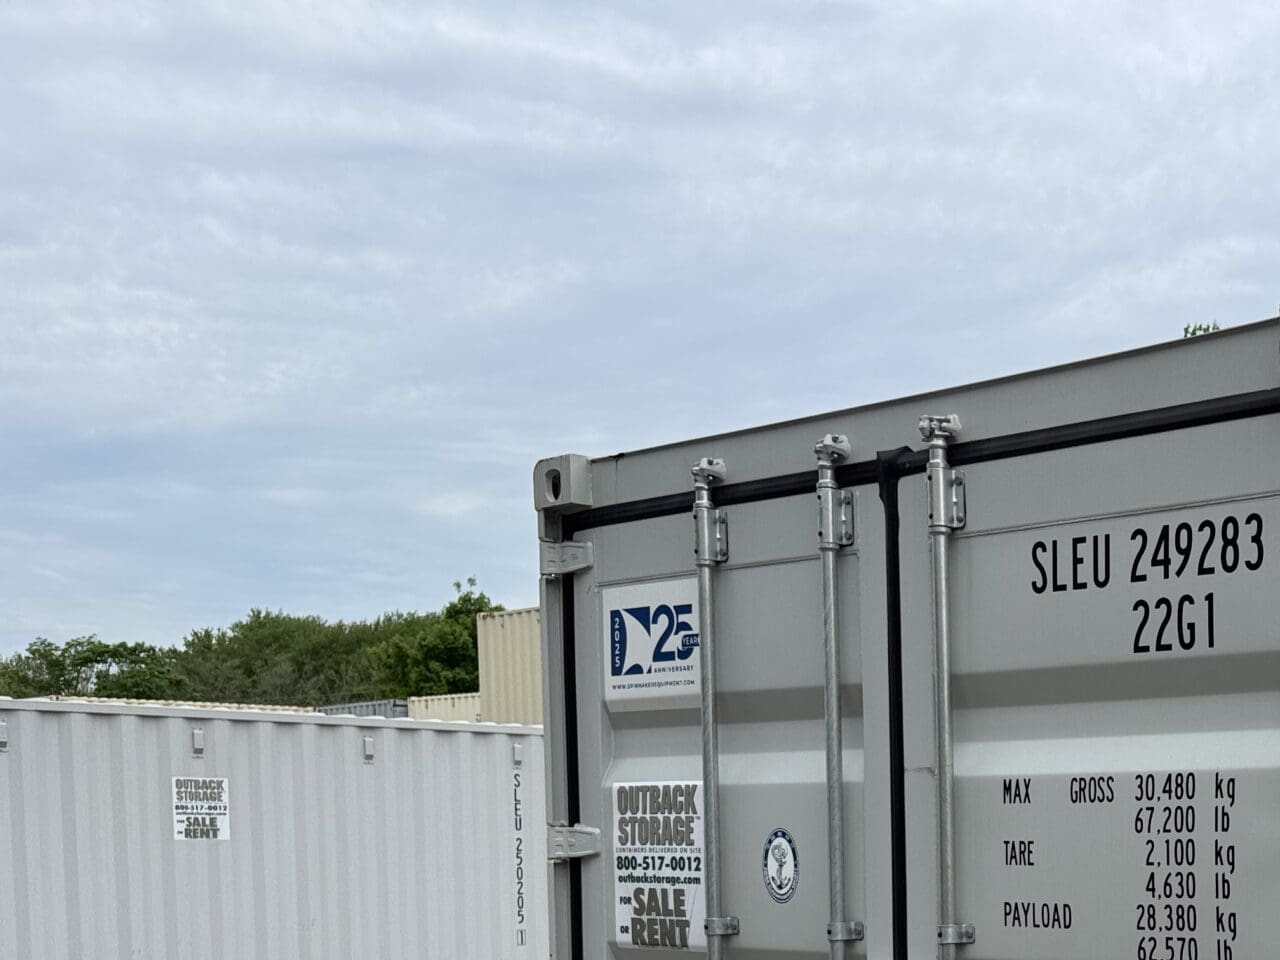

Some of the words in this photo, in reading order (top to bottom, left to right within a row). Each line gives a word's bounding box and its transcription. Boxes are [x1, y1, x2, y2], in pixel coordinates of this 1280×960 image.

[1031, 533, 1110, 594] SLEU
[1130, 513, 1264, 583] 249283
[651, 604, 693, 662] 25
[1132, 592, 1215, 653] 22G1
[654, 665, 694, 673] ANNIVERSARY
[175, 779, 224, 791] OUTBACK
[176, 790, 223, 802] STORAGE
[617, 784, 697, 815] OUTBACK
[1003, 778, 1031, 804] MAX
[1070, 776, 1115, 803] GROSS
[1134, 772, 1196, 802] 30,480
[1215, 772, 1235, 807] kg
[514, 773, 522, 831] SLEU
[184, 827, 219, 839] RENT
[186, 816, 217, 827] SALE
[618, 816, 694, 846] STORAGE
[1134, 806, 1196, 834] 67,200
[1214, 805, 1230, 832] lb
[617, 856, 701, 871] 800-517-0012
[1003, 840, 1035, 866] TARE
[1145, 838, 1196, 867] 2,100
[1214, 839, 1235, 874] kg
[516, 837, 524, 924] 250205
[618, 872, 701, 886] outbackstorage.com
[1145, 871, 1196, 900] 4,630
[1215, 872, 1231, 899] lb
[620, 896, 632, 905] FOR
[633, 887, 687, 917] SALE
[620, 926, 629, 934] OR
[631, 917, 690, 948] RENT
[1004, 902, 1072, 929] PAYLOAD
[1136, 904, 1197, 932] 28,380
[1216, 906, 1237, 941] kg
